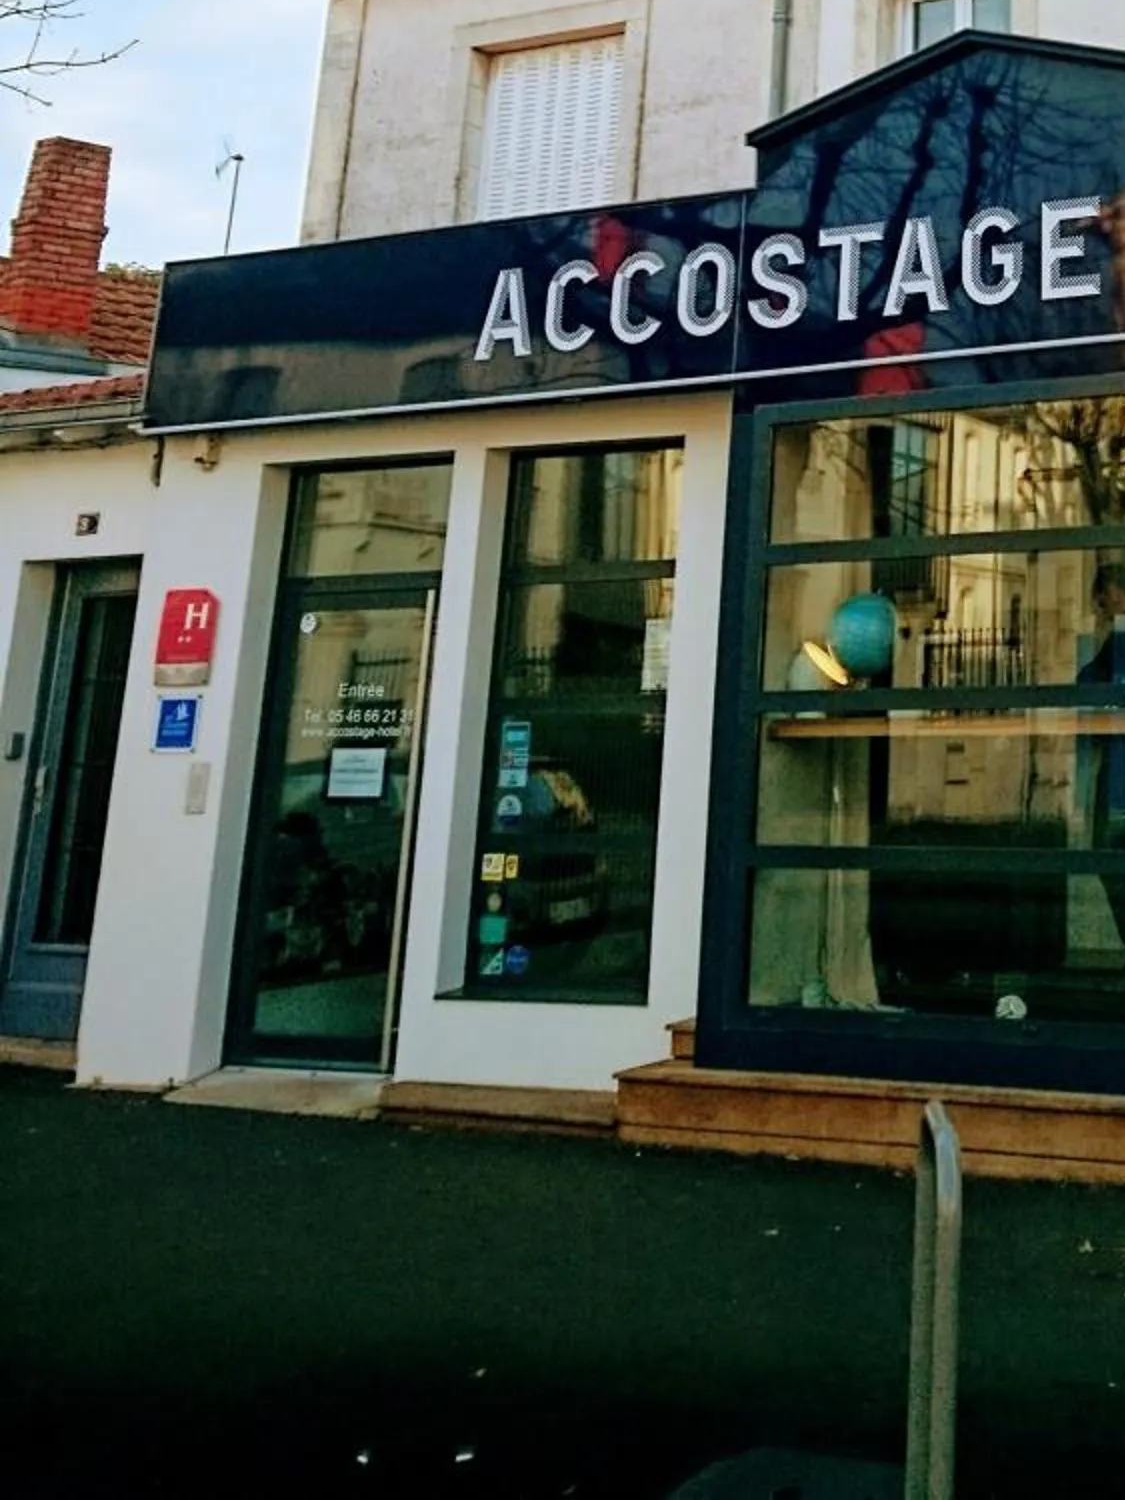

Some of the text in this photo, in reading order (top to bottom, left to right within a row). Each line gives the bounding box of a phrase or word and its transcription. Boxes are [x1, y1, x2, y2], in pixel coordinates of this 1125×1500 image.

[474, 195, 1102, 361] ACCOSTAGE
[184, 603, 209, 630] H
[338, 683, 385, 699] Entrée
[327, 709, 345, 722] 05
[381, 709, 397, 722] 21
